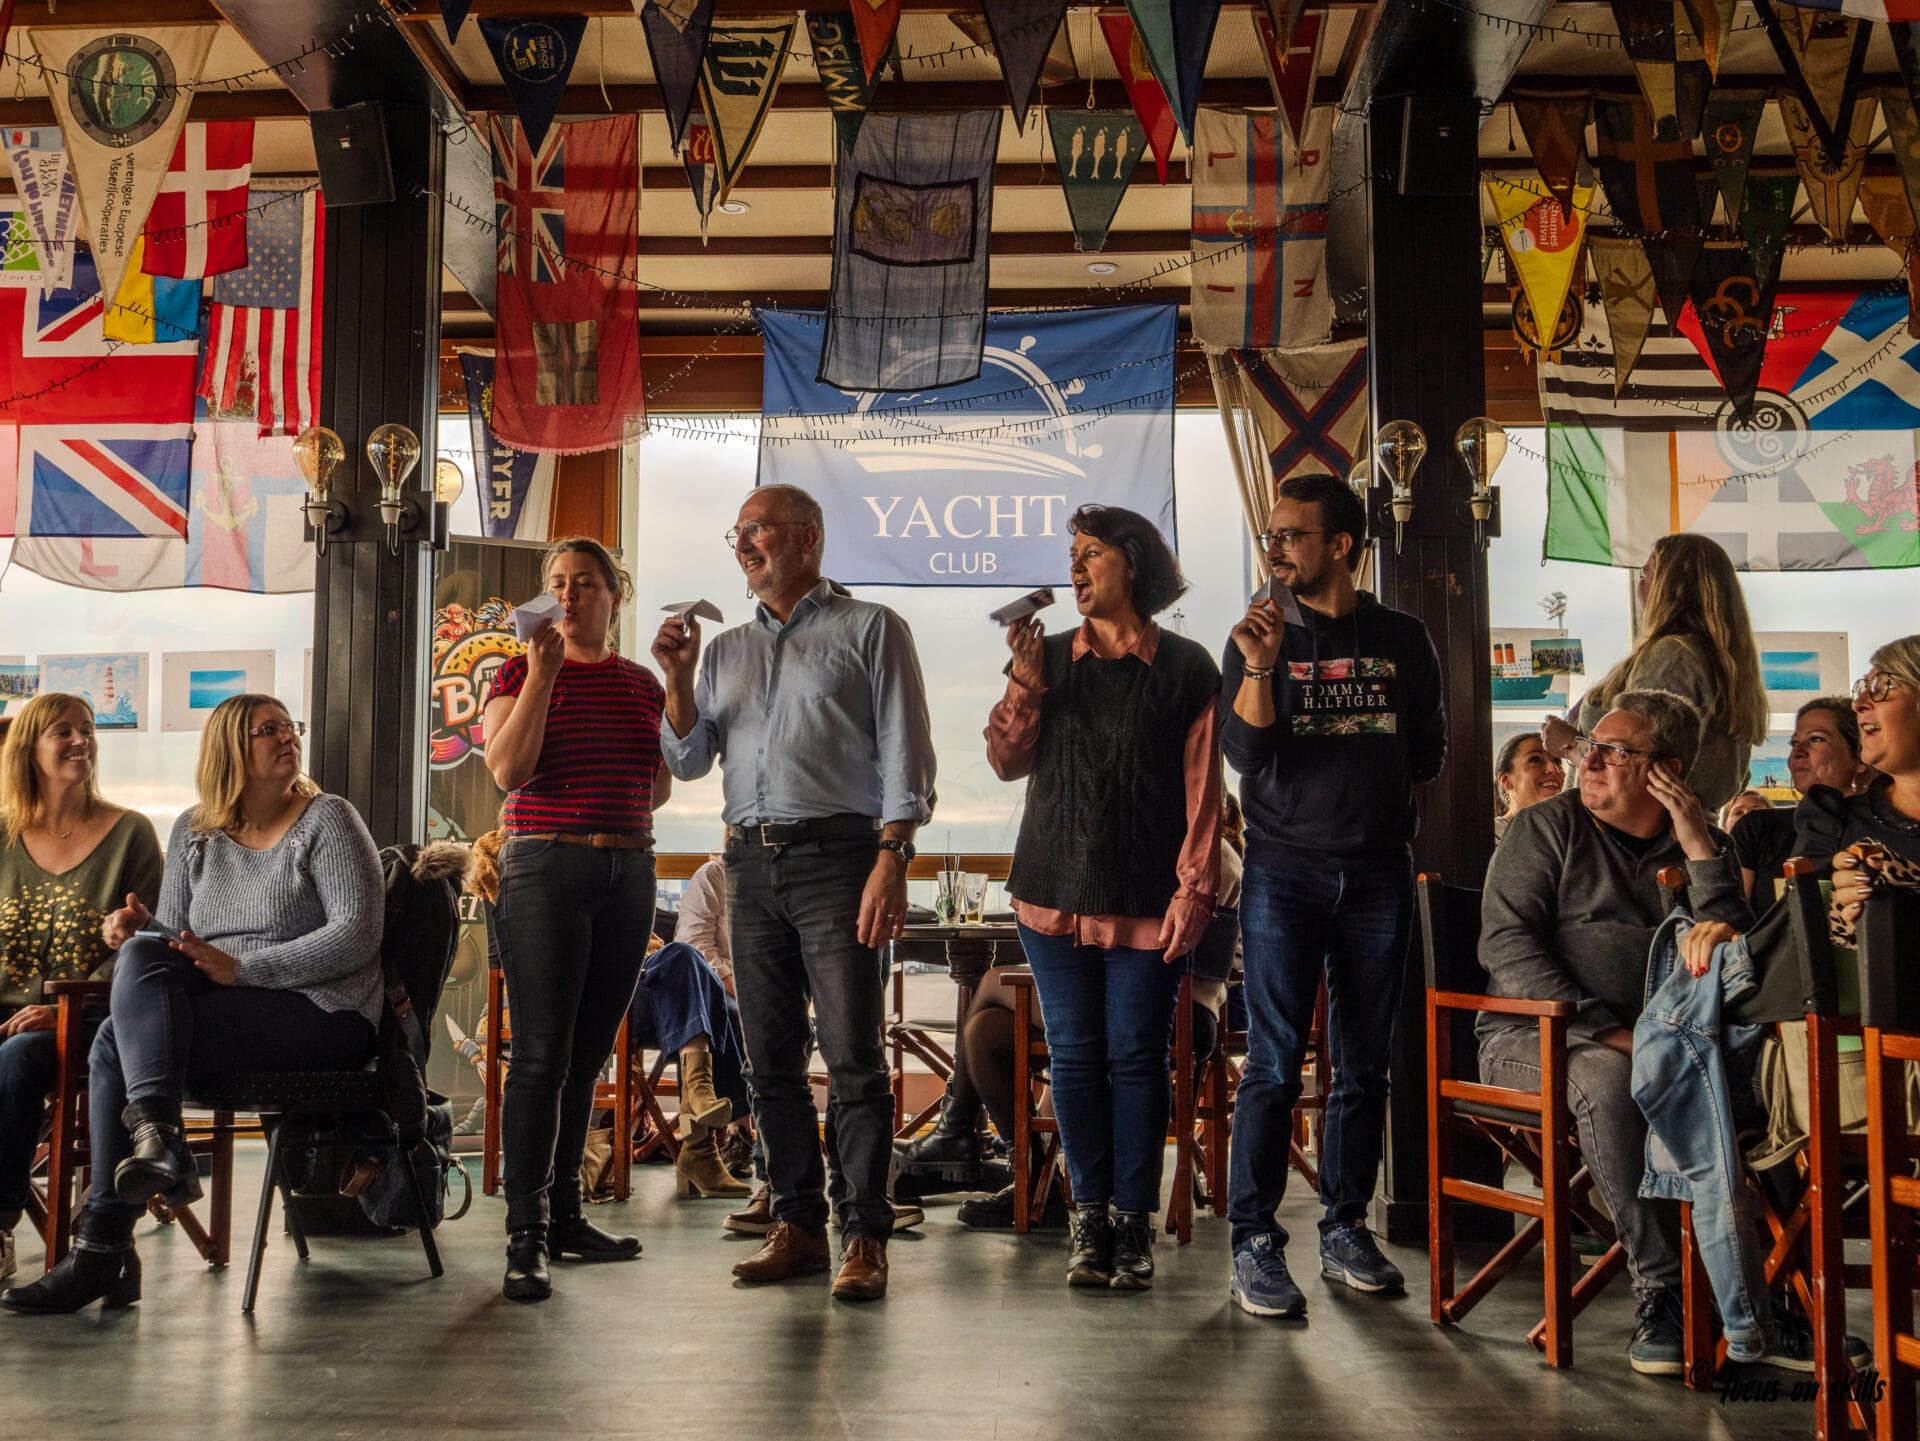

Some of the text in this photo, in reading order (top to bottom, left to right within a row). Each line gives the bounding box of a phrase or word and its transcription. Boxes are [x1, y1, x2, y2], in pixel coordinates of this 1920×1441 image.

[539, 35, 550, 70] DOVER
[114, 209, 131, 258] Europese
[861, 494, 1066, 539] YACHT
[929, 552, 997, 574] CLUB
[457, 895, 478, 920] EZ
